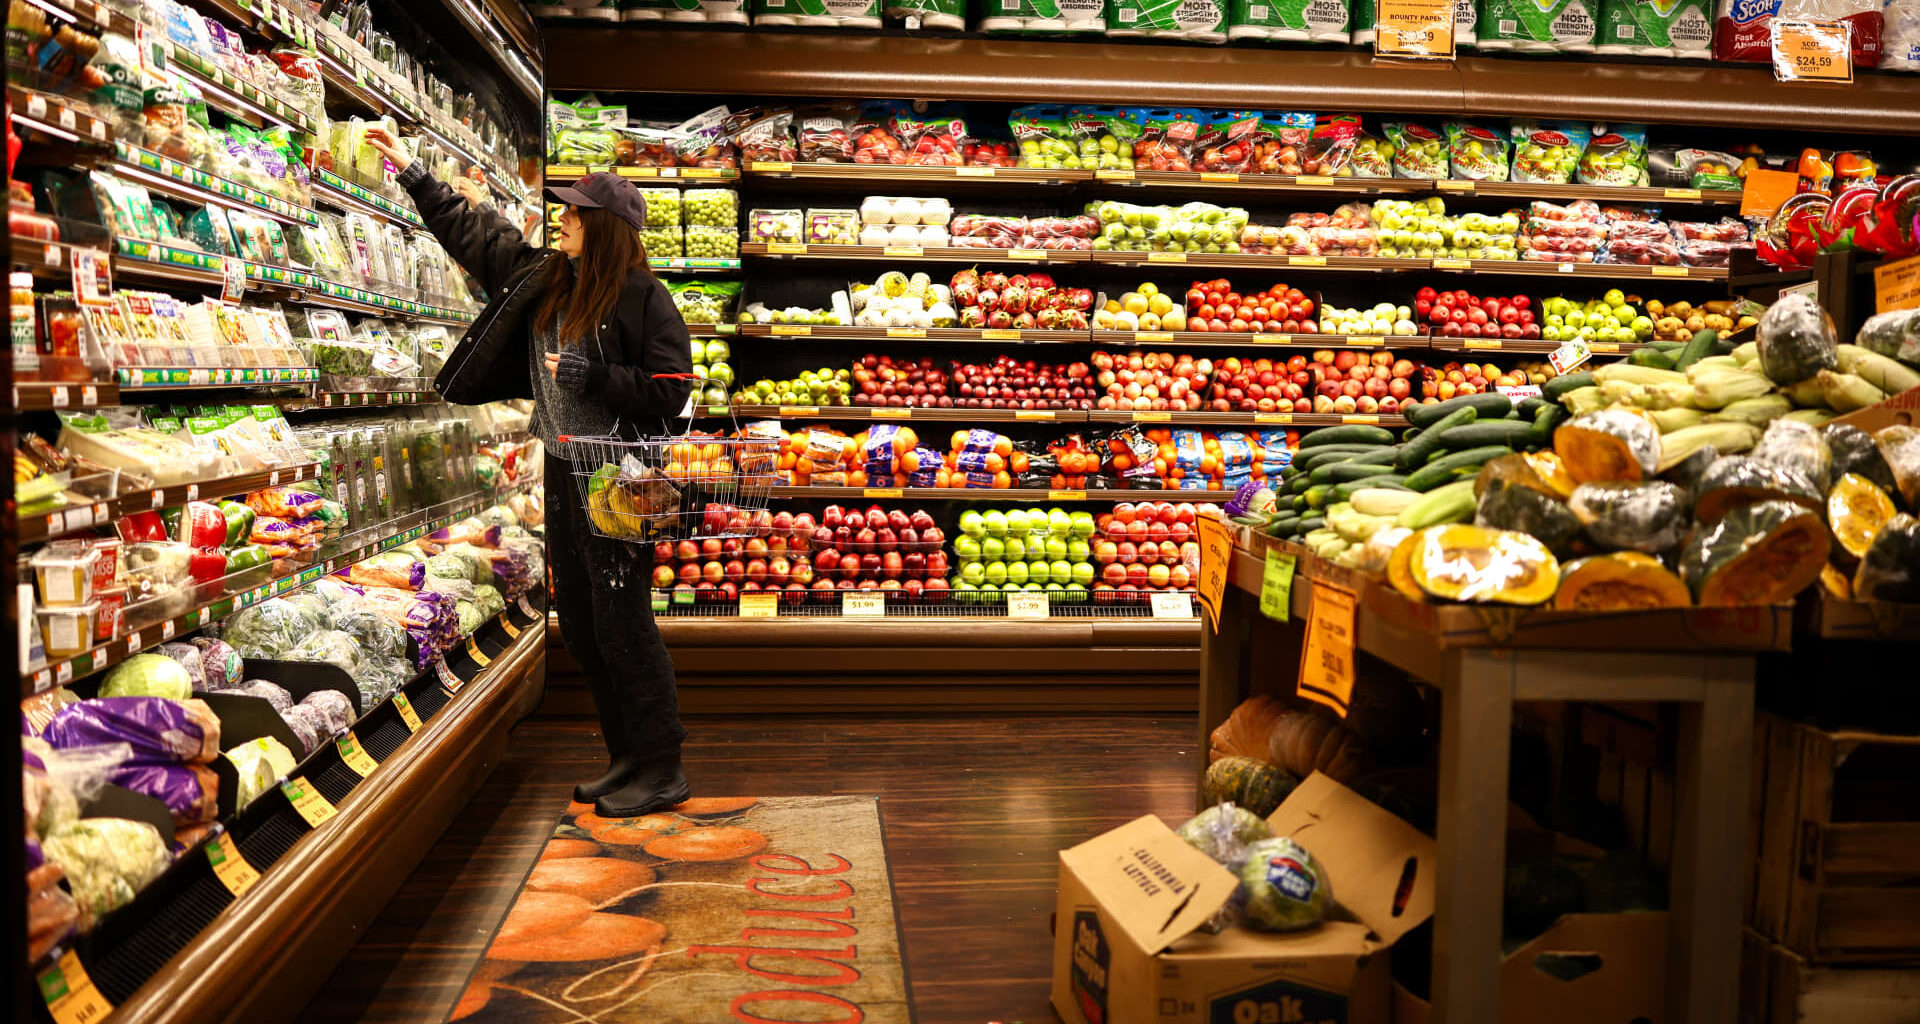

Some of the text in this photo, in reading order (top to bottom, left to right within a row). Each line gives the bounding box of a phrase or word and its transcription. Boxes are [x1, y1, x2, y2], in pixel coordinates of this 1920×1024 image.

[1314, 1, 1341, 11] MOST
[1561, 14, 1588, 23] MOST
[1553, 22, 1588, 30] STRENGTH
[1679, 20, 1706, 28] MOST
[1734, 33, 1754, 41] Fast
[1796, 55, 1832, 67] $24.59
[1134, 849, 1187, 894] CALIFORNIA
[1123, 863, 1161, 897] LETTUCE
[1233, 995, 1304, 1024] Oak
